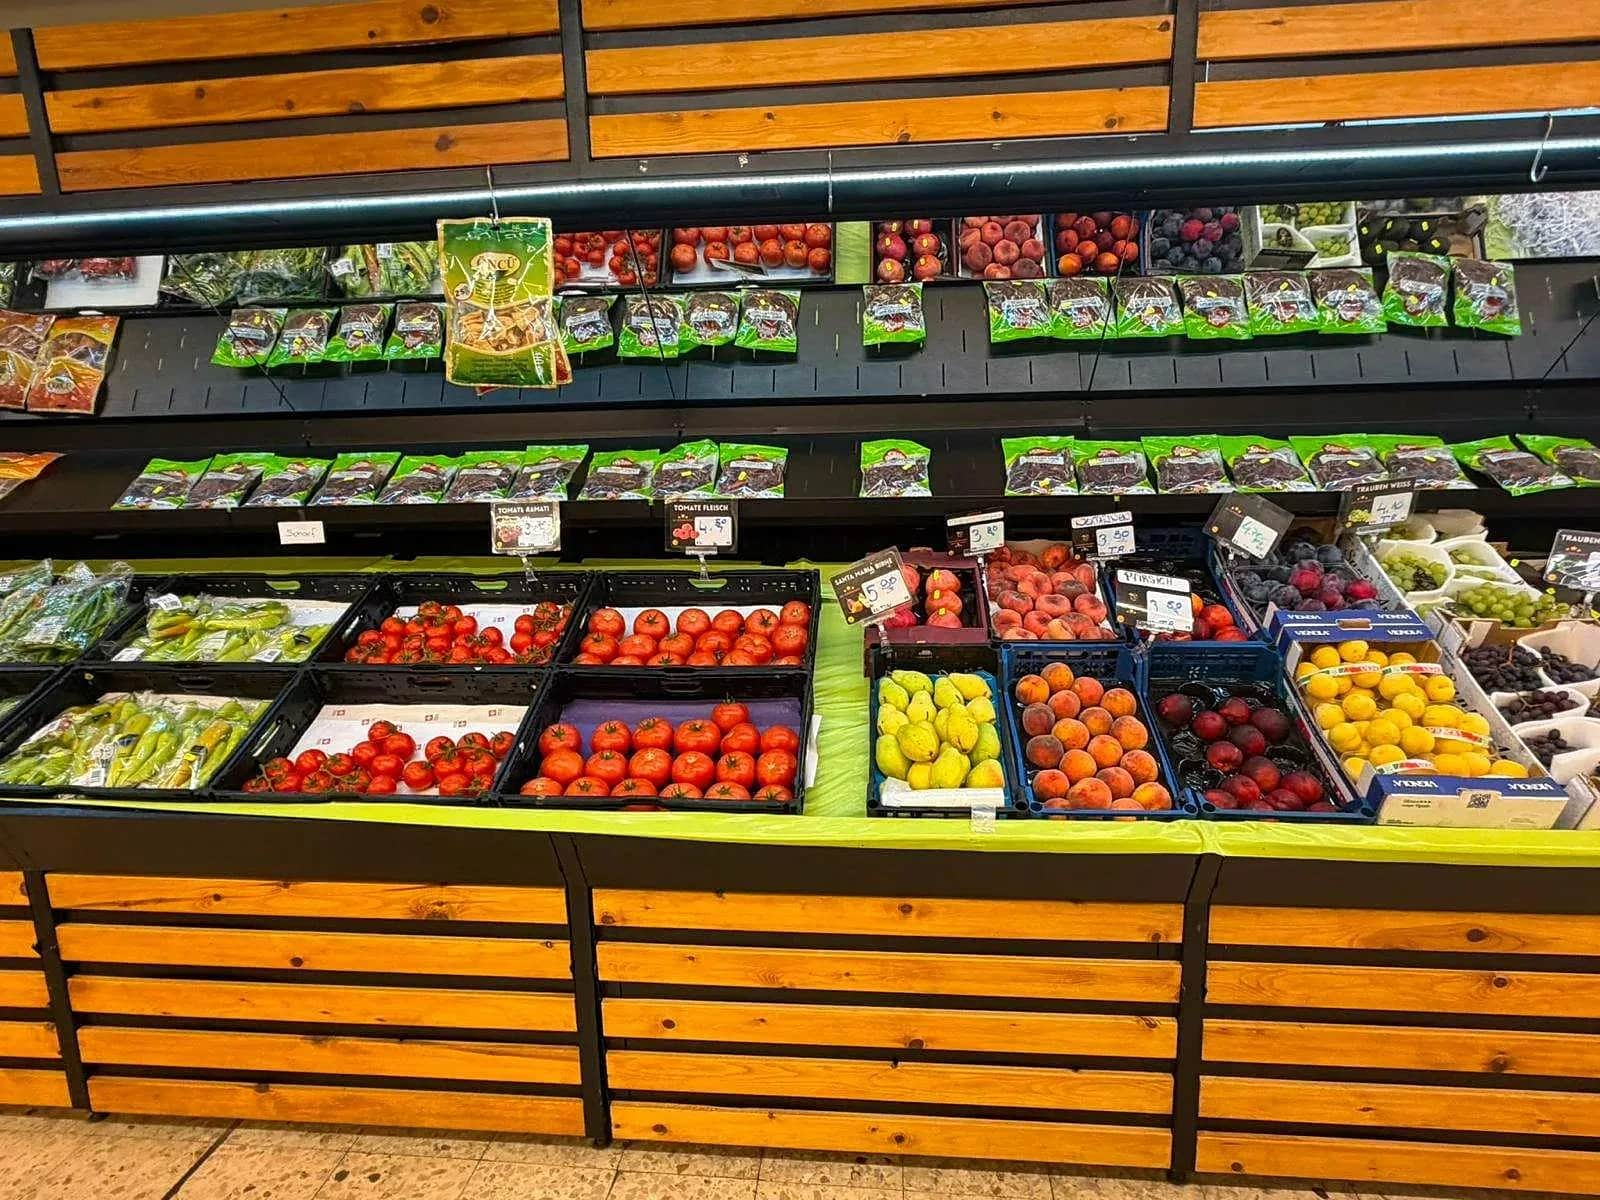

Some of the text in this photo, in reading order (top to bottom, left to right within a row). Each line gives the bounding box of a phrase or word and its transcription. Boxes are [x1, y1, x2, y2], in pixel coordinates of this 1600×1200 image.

[1357, 480, 1411, 493] TRAUBEN WEISS
[1561, 534, 1600, 544] TRAUBEN
[834, 574, 855, 586] SANTA
